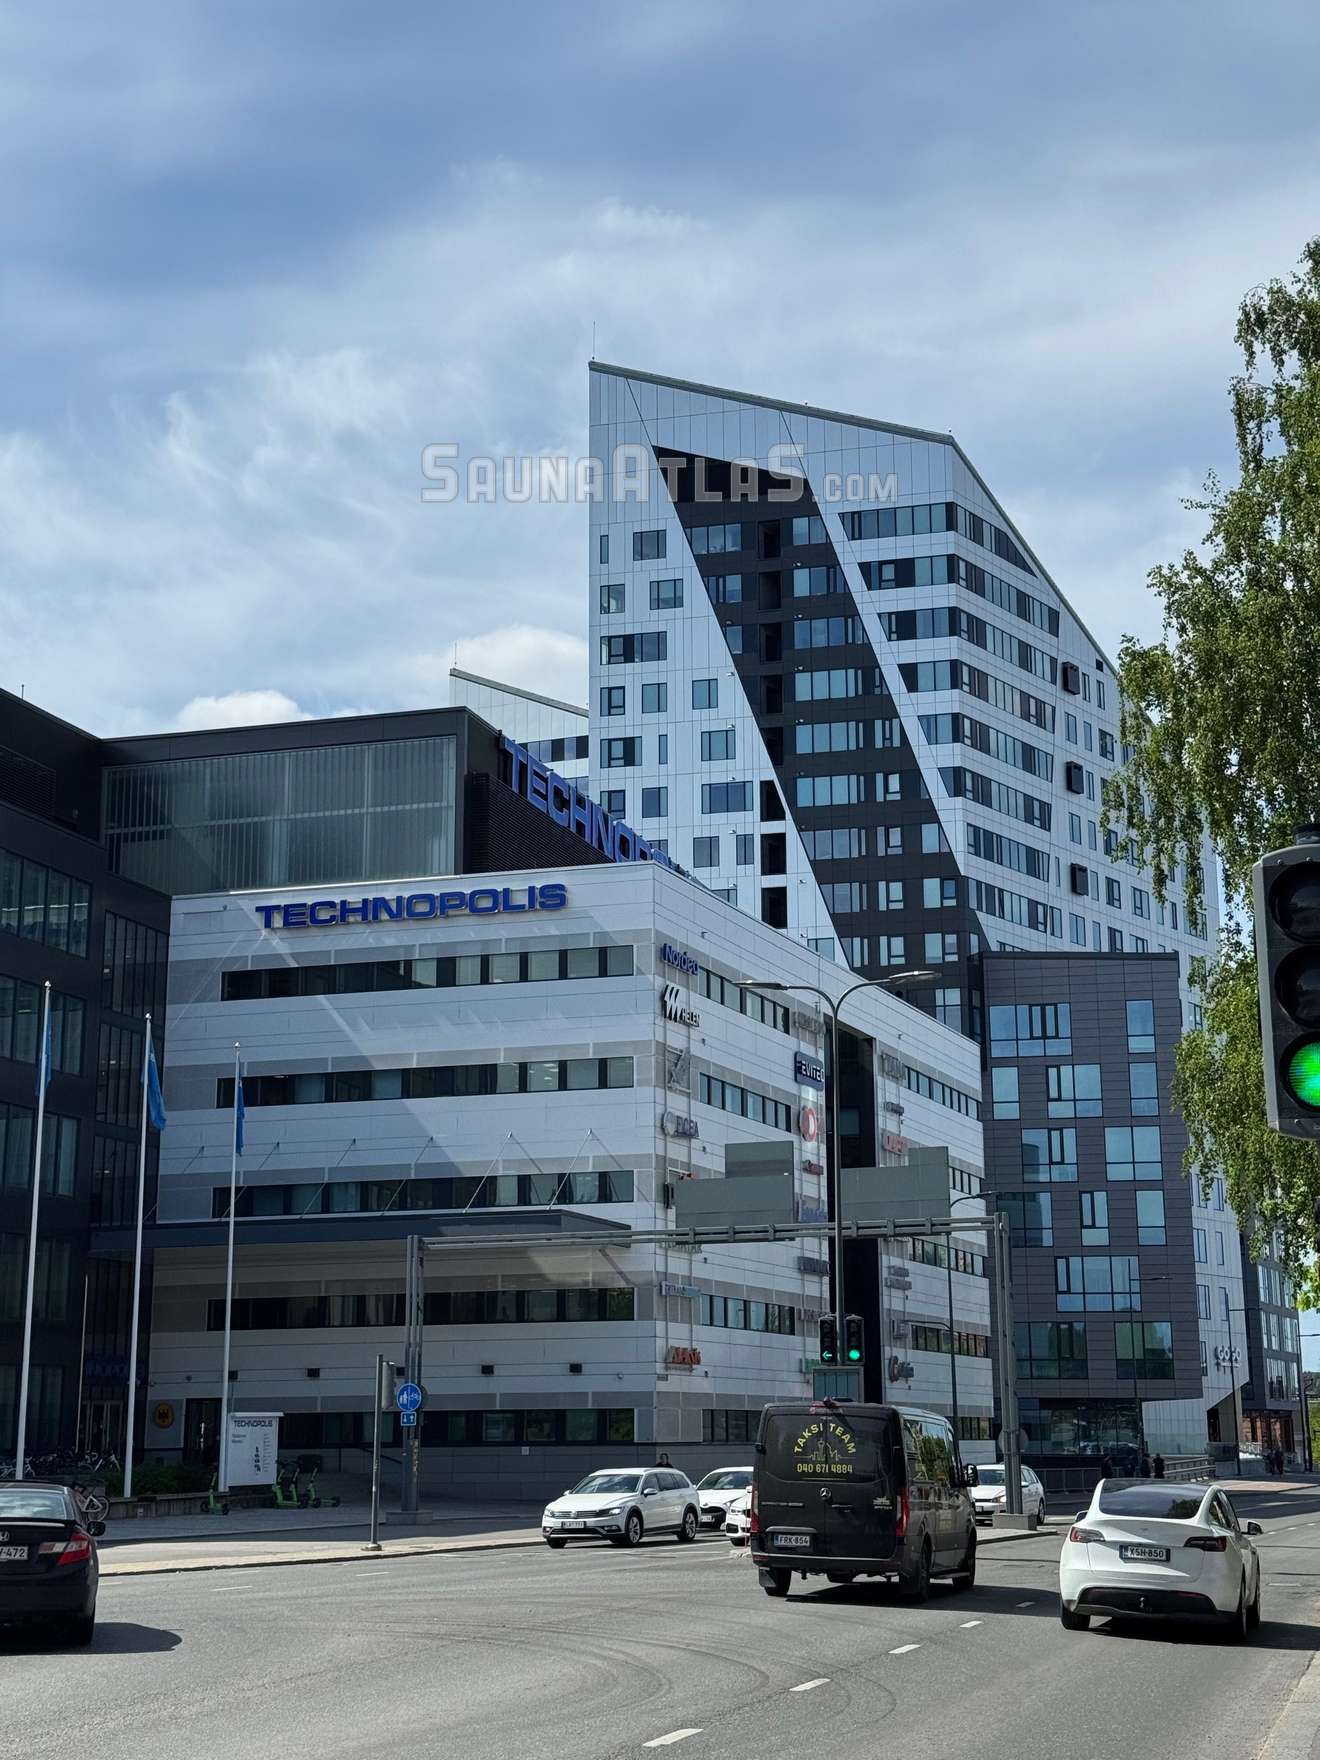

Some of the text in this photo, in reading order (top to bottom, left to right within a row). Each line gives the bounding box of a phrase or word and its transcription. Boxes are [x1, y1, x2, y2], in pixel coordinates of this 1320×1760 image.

[255, 883, 568, 930] TECHNOPOLIS
[794, 1422, 857, 1454] TAKSI TEAM
[797, 1463, 853, 1474] 040 671 4884
